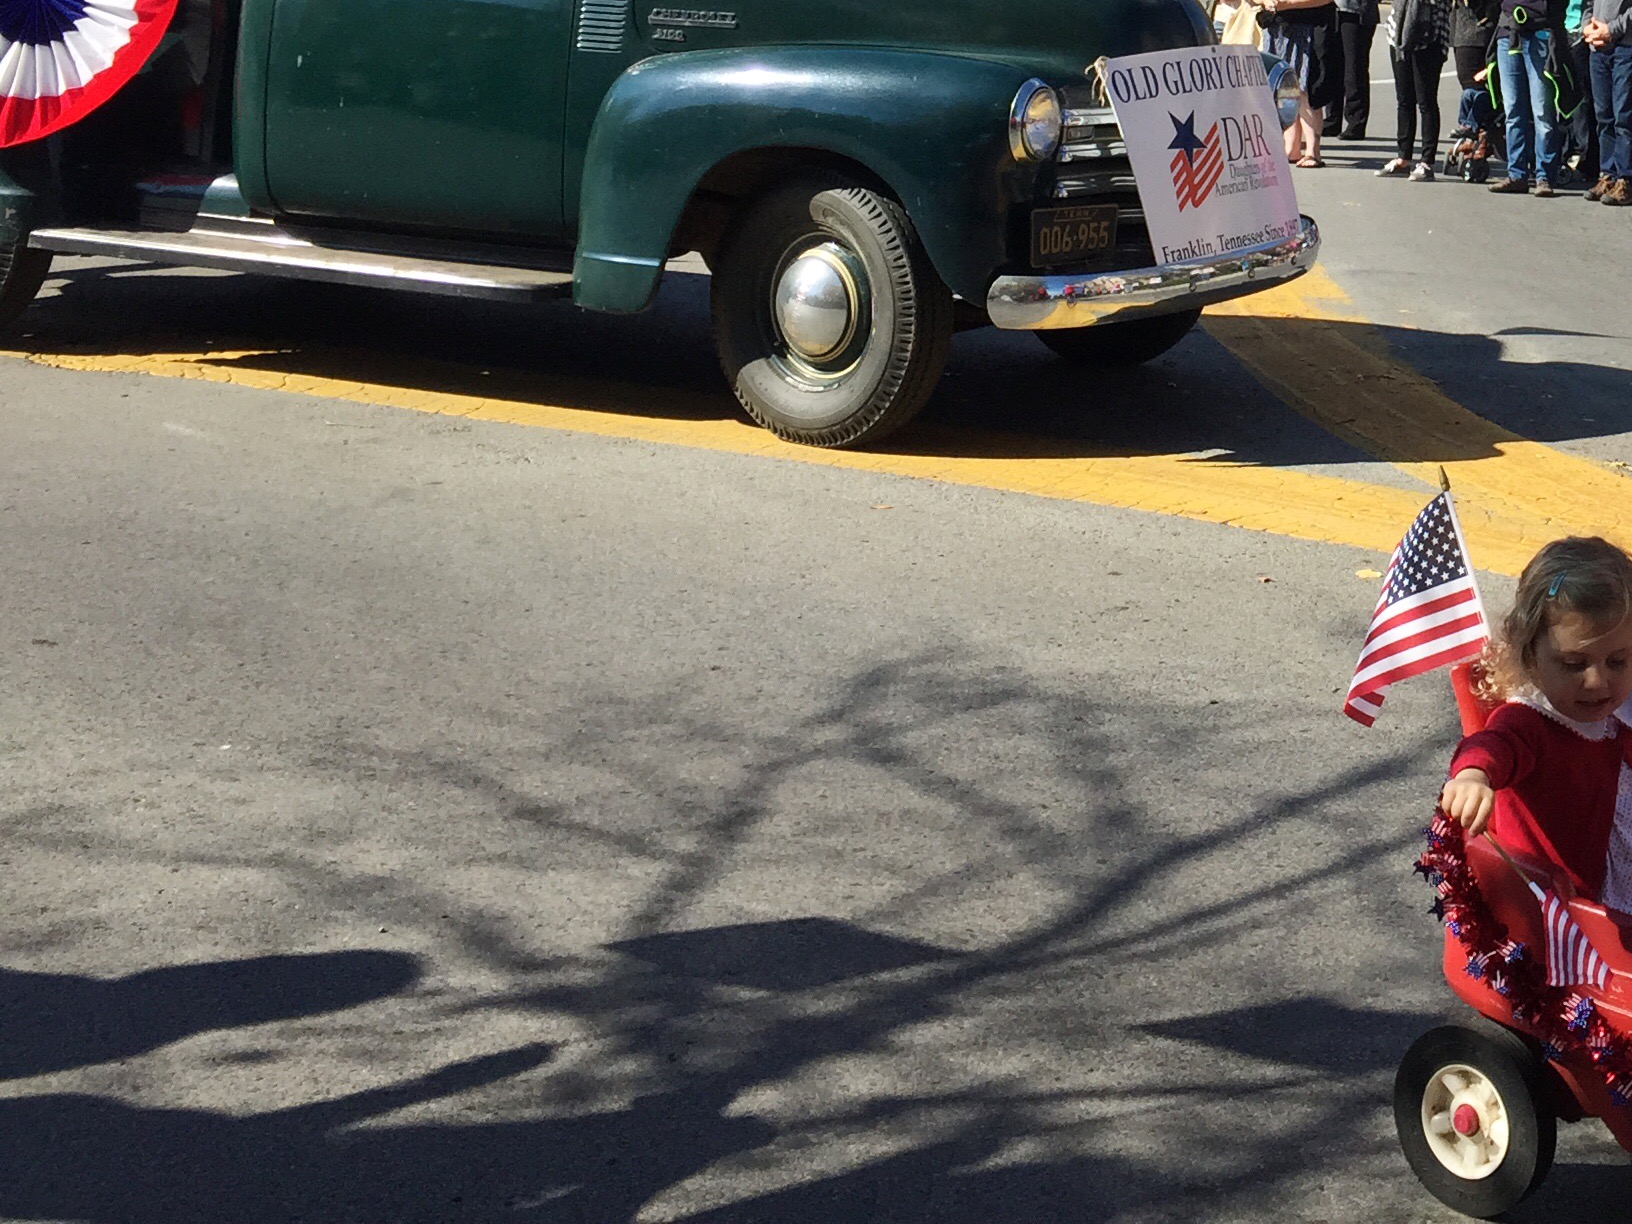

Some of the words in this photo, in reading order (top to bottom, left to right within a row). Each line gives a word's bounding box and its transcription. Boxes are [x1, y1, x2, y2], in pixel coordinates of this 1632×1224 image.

[1111, 65, 1159, 104] OLD
[1162, 56, 1225, 96] GLORY
[1220, 113, 1272, 162] DAR
[1215, 178, 1248, 196] American
[1162, 238, 1217, 264] Franklin,
[1217, 229, 1264, 253] Tennessee
[1264, 223, 1285, 243] Since
